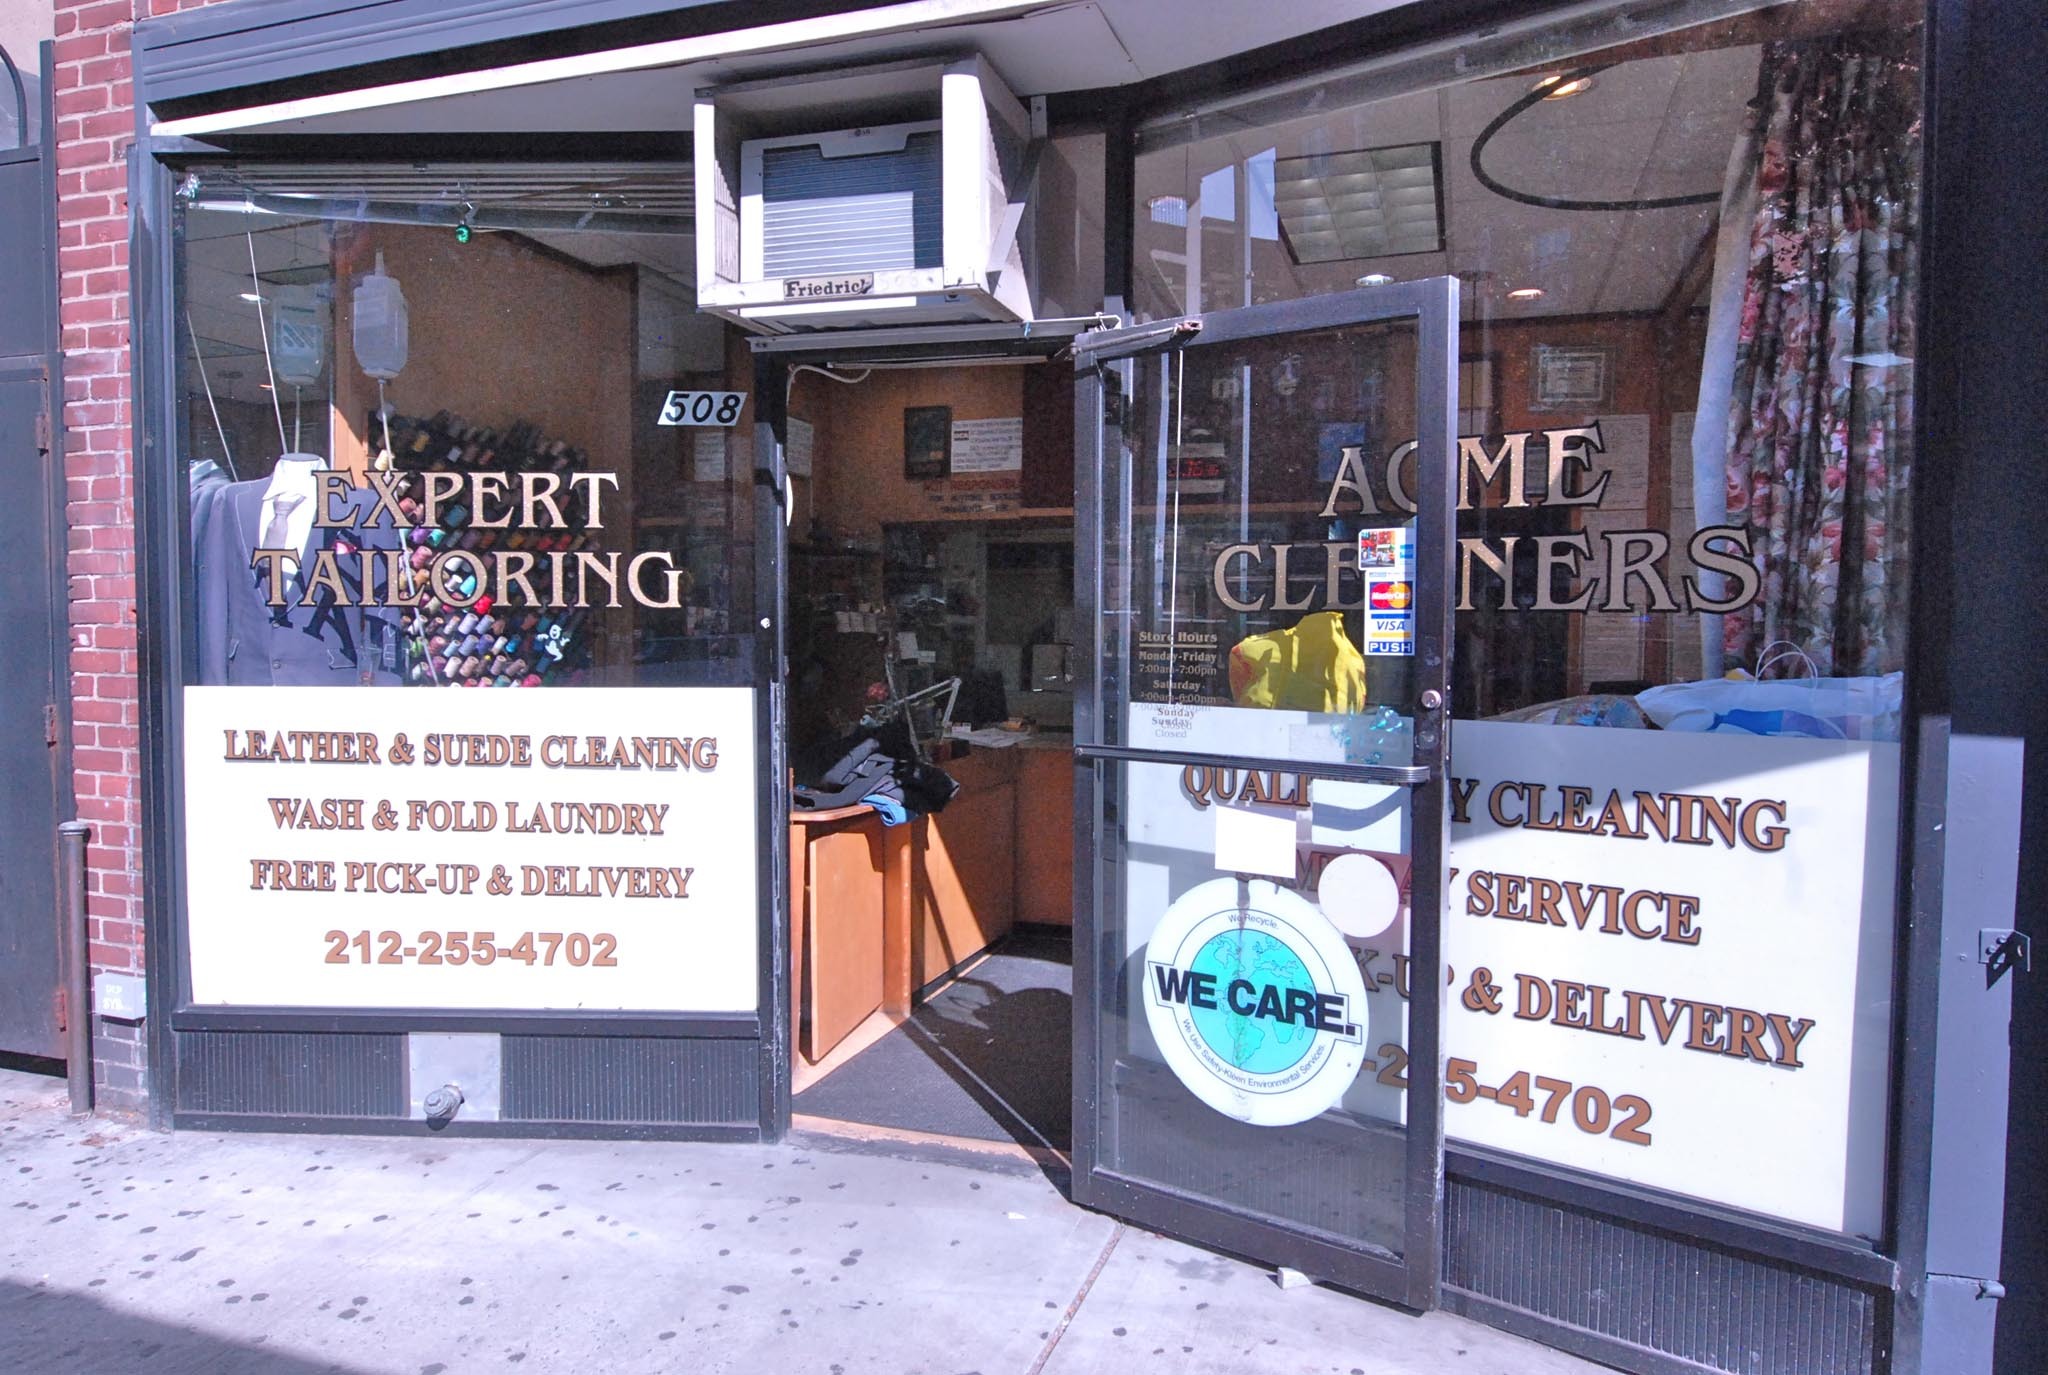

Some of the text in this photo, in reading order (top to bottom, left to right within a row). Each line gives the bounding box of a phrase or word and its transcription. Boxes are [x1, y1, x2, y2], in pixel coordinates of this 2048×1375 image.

[665, 393, 741, 424] 508
[312, 468, 620, 529] EXPERT
[250, 549, 685, 609] TAILORING
[1213, 525, 1761, 613] CLENERS
[1139, 631, 1217, 643] Store Hours
[1376, 621, 1406, 631] VISA
[1139, 651, 1217, 664] Monday-Friday
[1369, 642, 1411, 652] PUSH
[1140, 691, 1217, 704] :00am-6:00pm
[1153, 680, 1201, 692] Saturday
[223, 730, 719, 770] LEATHER & SUEDE CLEANING
[268, 798, 669, 834] WASH & FOLD LAUNDRY
[1184, 765, 1311, 807] QUALI
[1488, 781, 1790, 851] CLEANING
[250, 859, 694, 898] FREE PICK-UP & DELIVERY
[1243, 913, 1279, 930] Recycle.
[1467, 870, 1701, 944] SERVICE
[324, 930, 618, 967] 212-255-4702
[1155, 965, 1356, 1036] WE CARE.
[1463, 967, 1502, 1013] &
[1515, 973, 1815, 1068] DELIVERY
[1202, 1049, 1246, 1085] Safety-Kleen
[1247, 1070, 1301, 1089] Environmental
[1299, 1043, 1327, 1075] Services.
